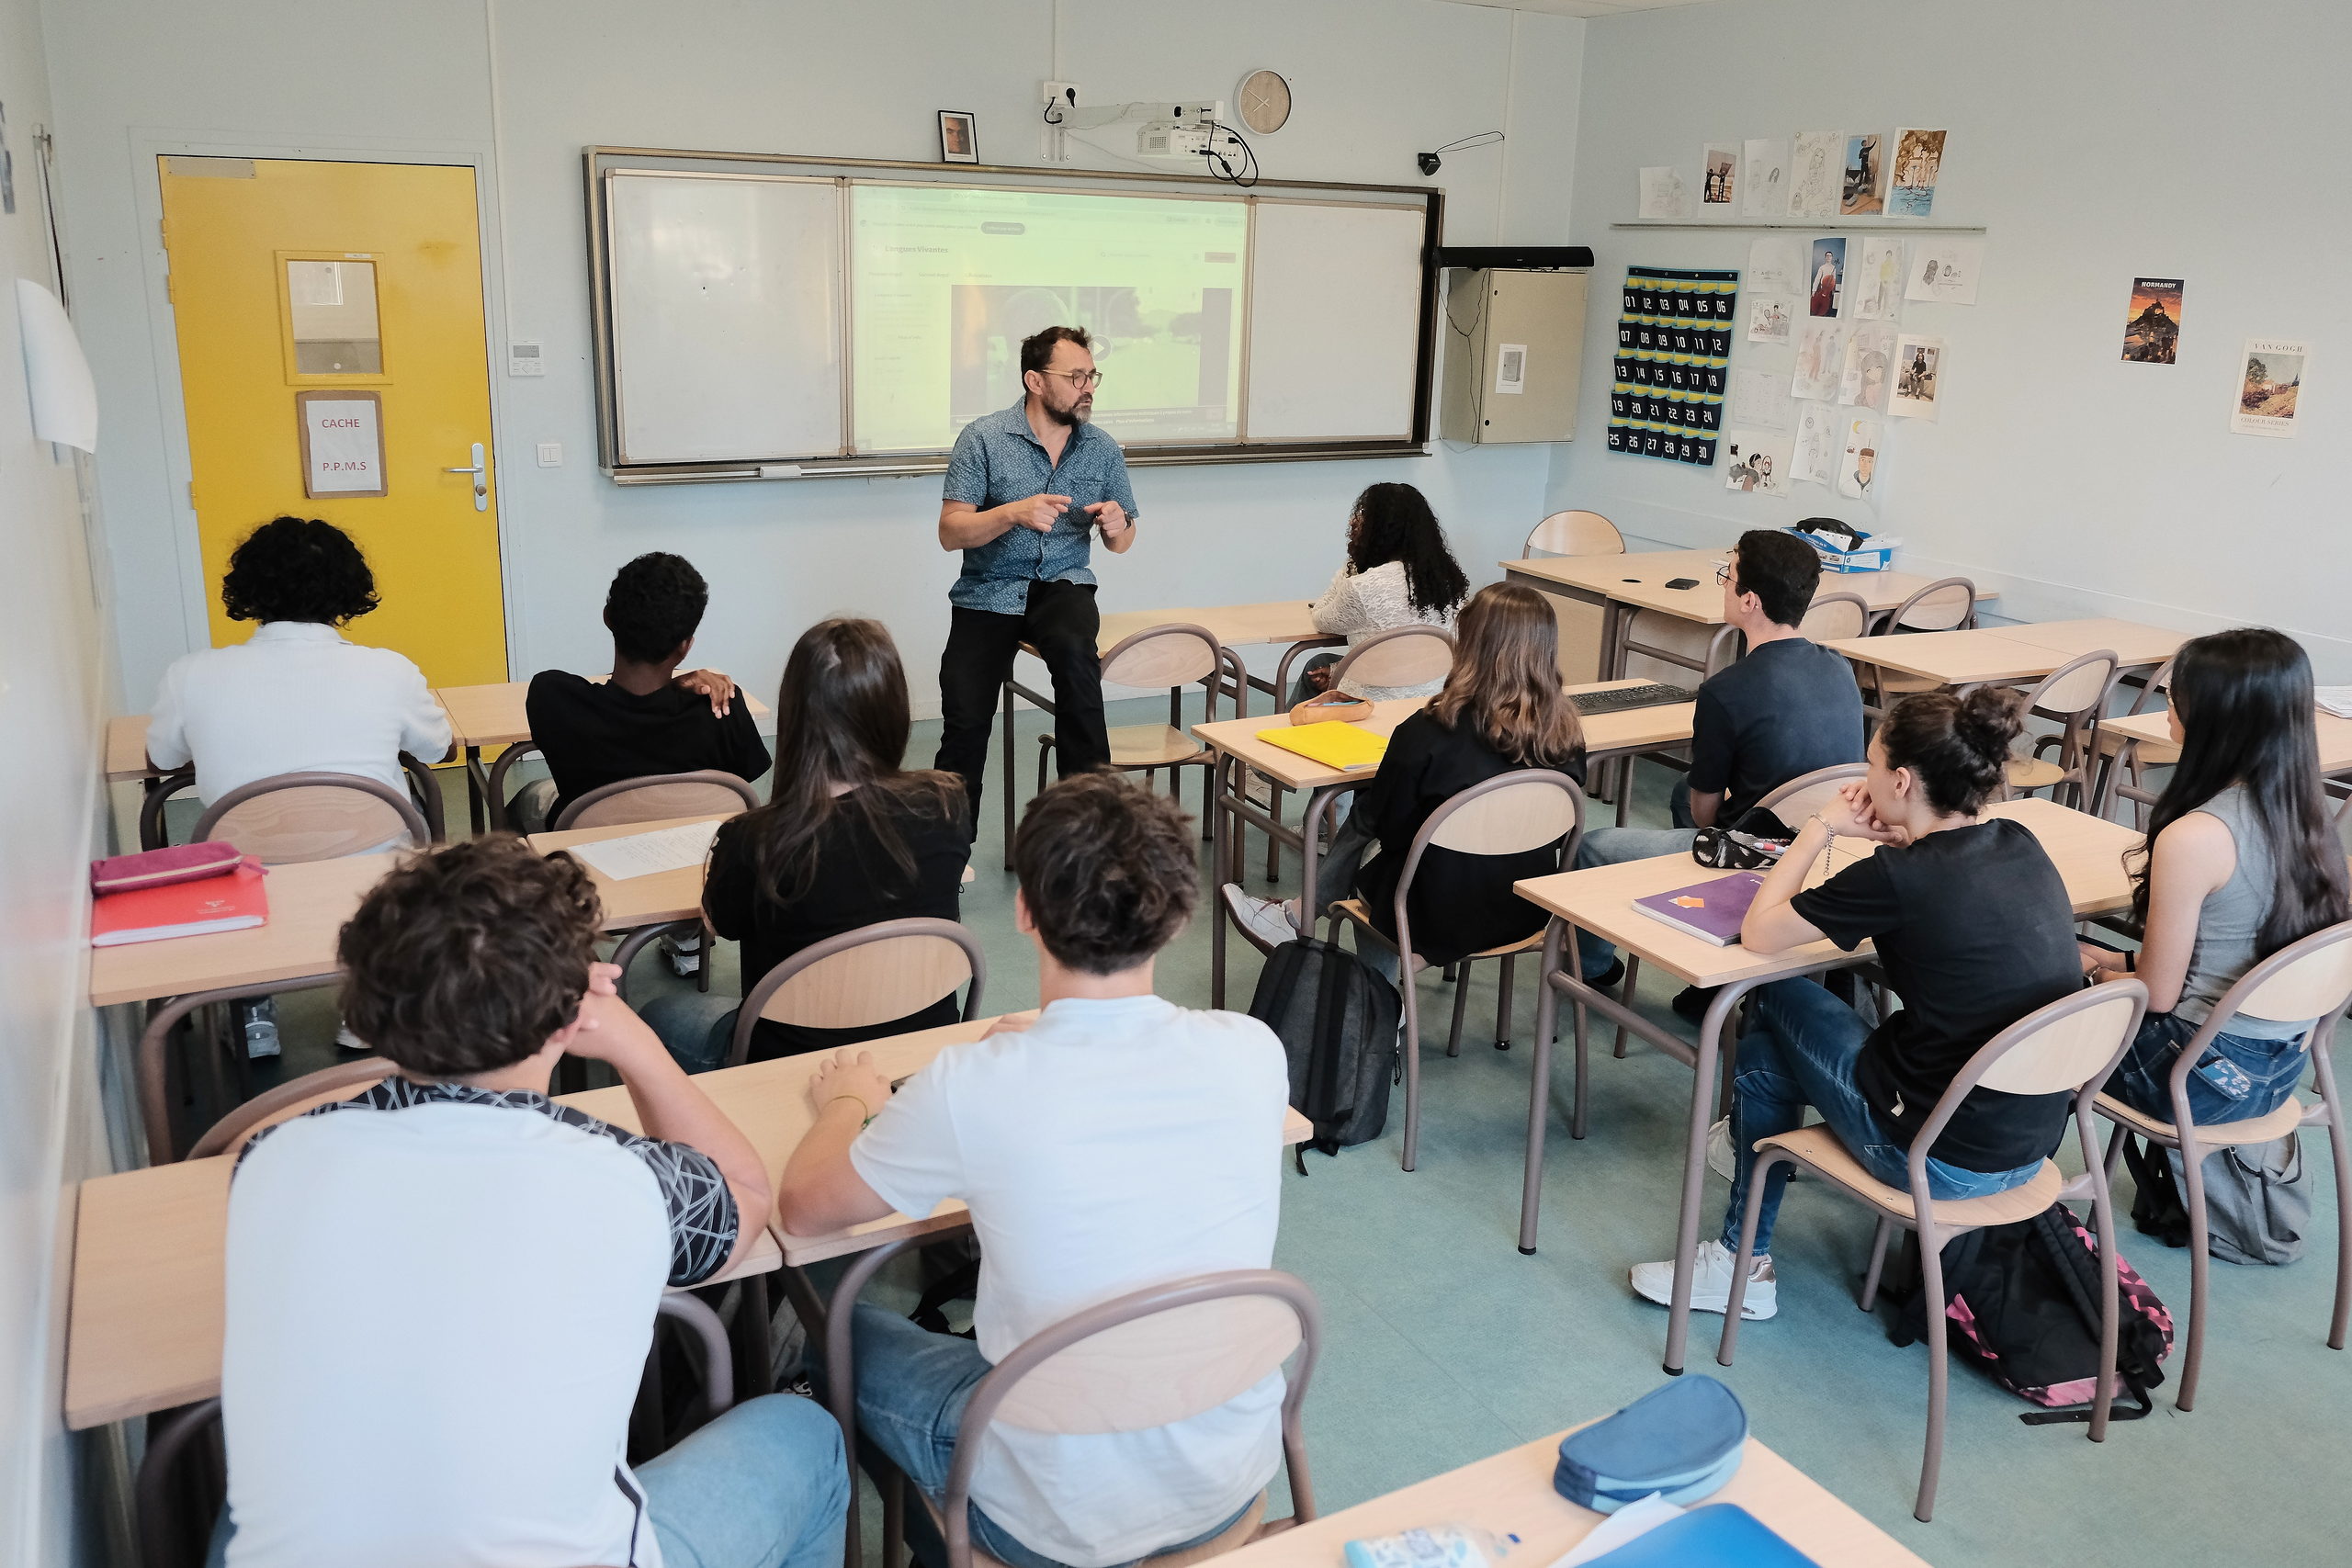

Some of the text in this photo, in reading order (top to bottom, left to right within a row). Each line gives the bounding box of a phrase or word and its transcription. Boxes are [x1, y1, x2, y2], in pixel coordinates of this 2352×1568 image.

[917, 245, 948, 254] Vivantes
[1625, 296, 1725, 312] 01 02 03 04 05 06
[1621, 331, 1722, 351] 07 08 09 10 11 12
[2275, 344, 2303, 353] GOGH
[1617, 366, 1717, 387] 13 14 15 16 17 18
[1613, 400, 1713, 423] 19 20 21 22 23 24
[322, 418, 360, 428] CACHE
[1610, 434, 1706, 458] 25 26 27 28 29 30
[322, 461, 367, 472] P.P.M.S
